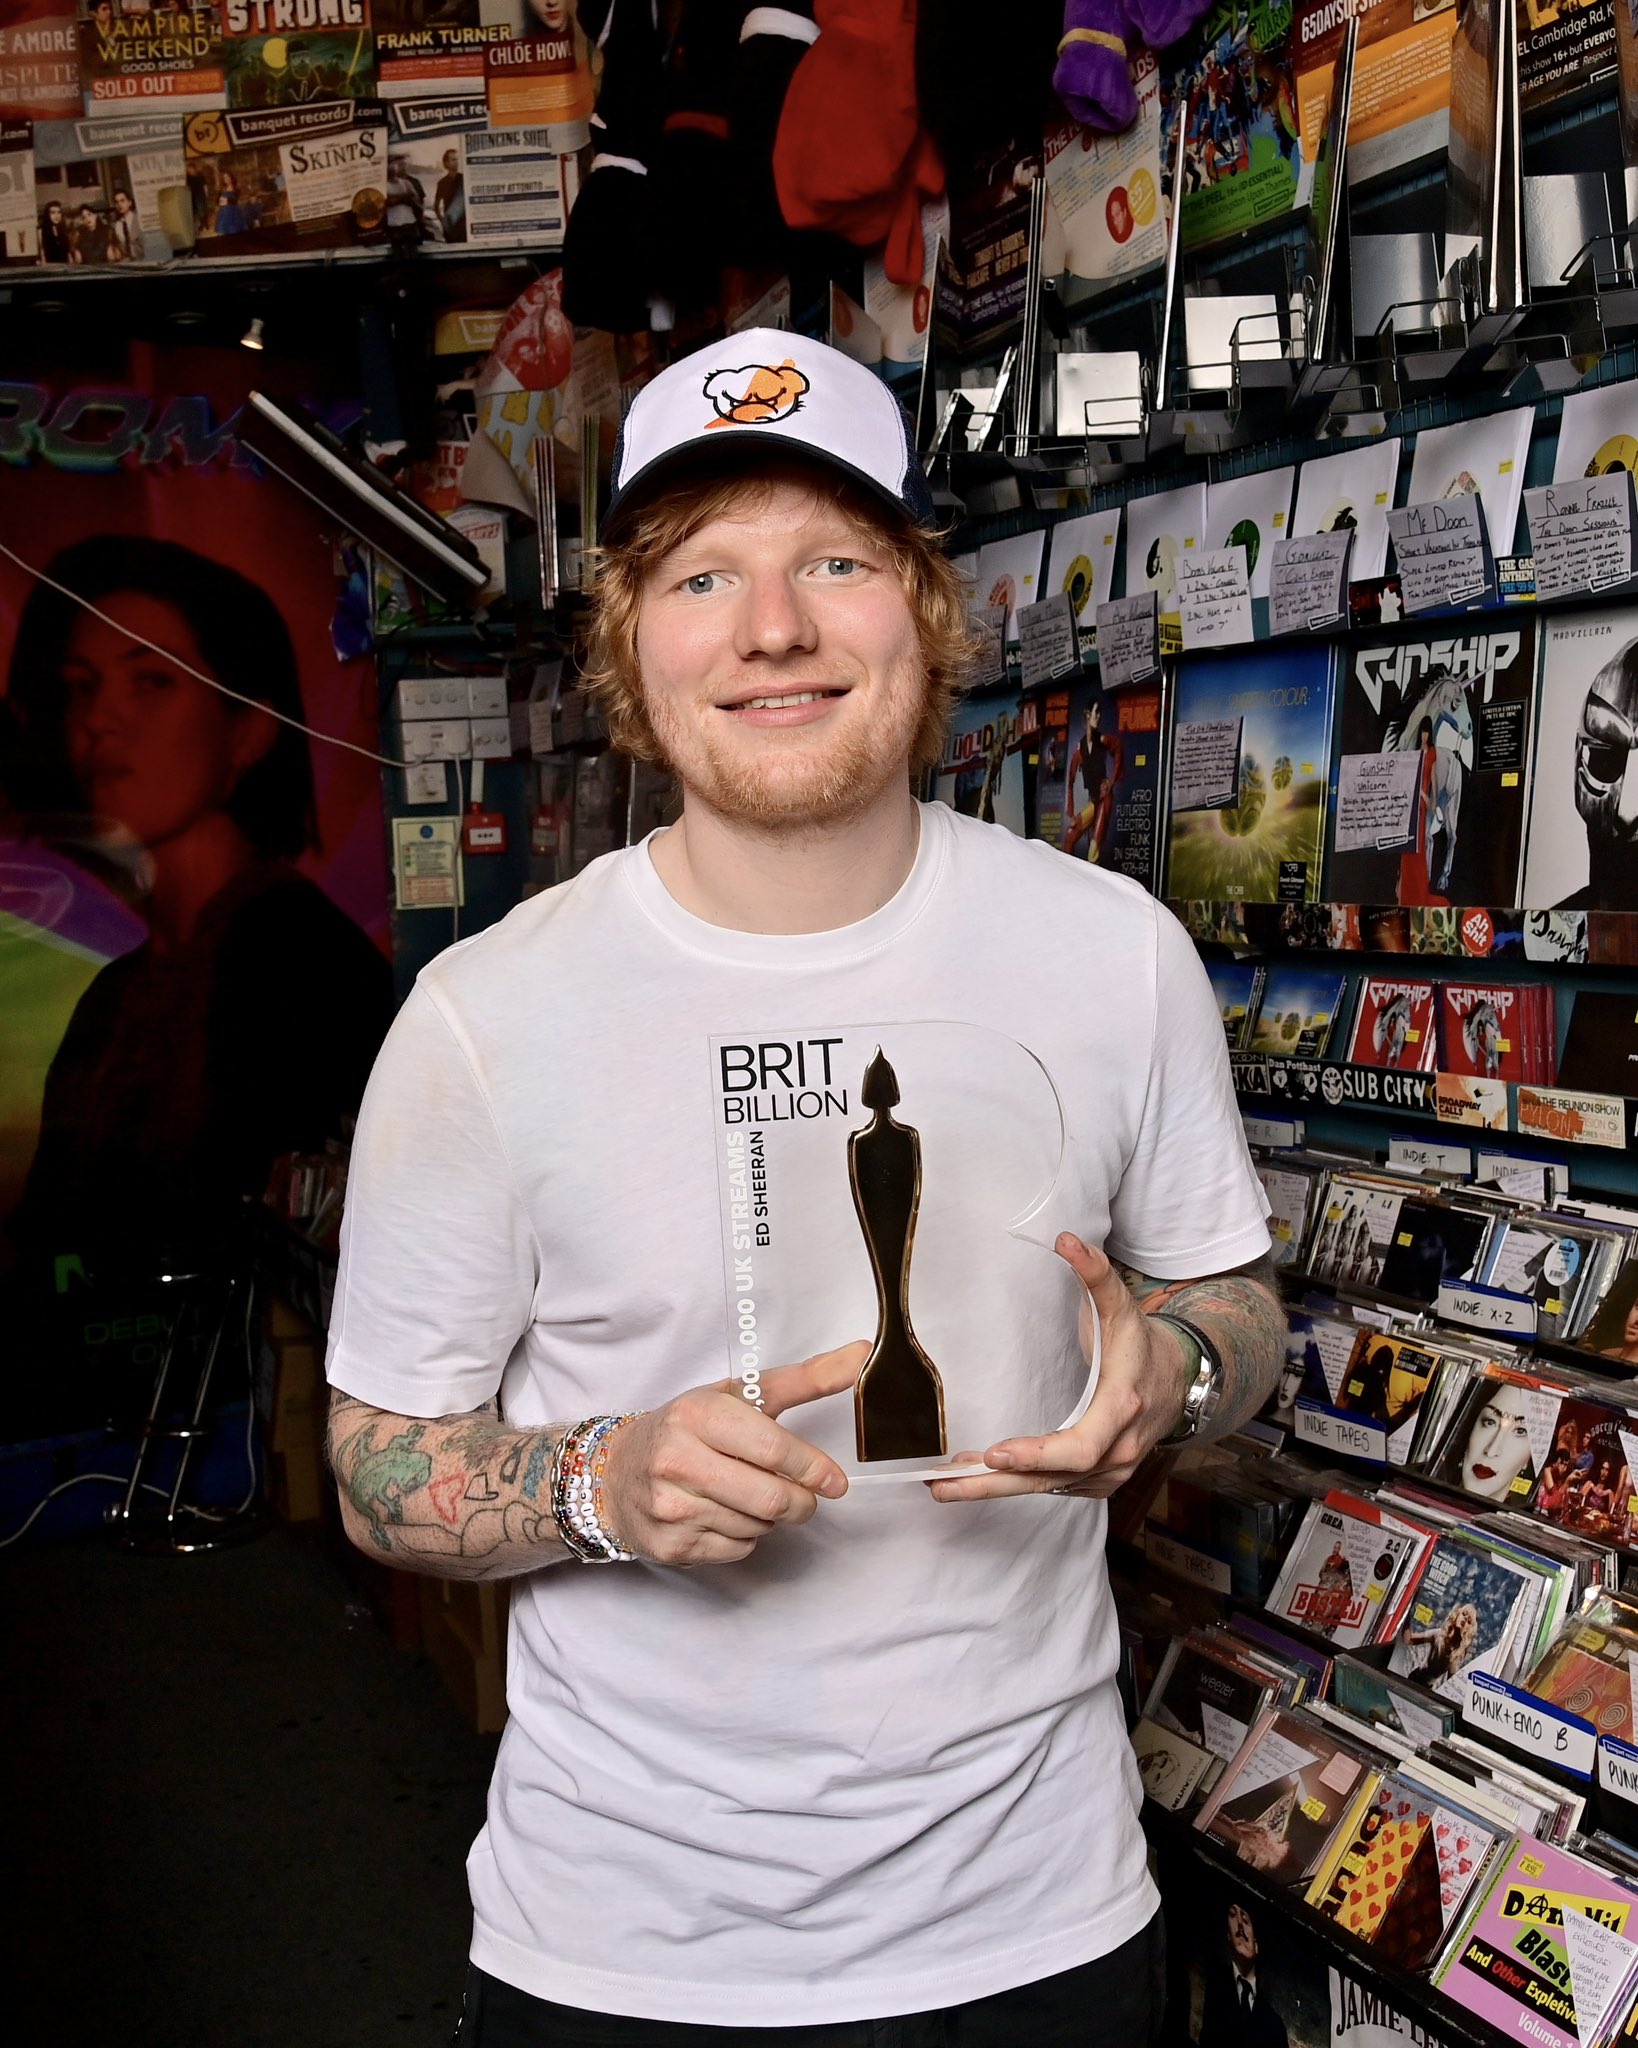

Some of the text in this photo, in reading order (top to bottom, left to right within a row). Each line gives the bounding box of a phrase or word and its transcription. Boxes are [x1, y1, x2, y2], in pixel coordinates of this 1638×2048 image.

[95, 13, 206, 38] VAMPIRE
[376, 26, 512, 49] FRANK TURNER
[1531, 16, 1588, 51] Cambridge
[13, 26, 76, 54] AMORÉ
[97, 37, 210, 61] WEEKEND
[489, 42, 533, 66] CHLÖE
[1532, 56, 1552, 72] show
[1553, 48, 1569, 62] 16+
[1569, 43, 1583, 56] but
[121, 59, 195, 74] GOOD SHOES
[1528, 74, 1544, 90] AGE
[1545, 66, 1561, 81] YOU
[1562, 60, 1580, 75] ARE
[93, 75, 175, 99] SOLD OUT
[240, 106, 383, 134] banquet records .com
[409, 103, 466, 122] banquet
[89, 122, 146, 141] banquet
[289, 130, 377, 175] SKINTS
[1499, 558, 1516, 571] THE
[1499, 571, 1535, 581] ANTHEM
[1355, 631, 1520, 716] GUNSHIP
[1118, 705, 1158, 730] FUNK
[1131, 789, 1152, 802] AFRO
[1116, 803, 1152, 818] FUTURIST
[1116, 818, 1151, 832] ELECTRO
[1130, 833, 1151, 846] FUNK
[1124, 847, 1150, 861] SPACE
[1469, 912, 1489, 931] Ah
[1368, 981, 1432, 1012] GUNSHIP
[1446, 986, 1514, 1020] GUNSHIP
[720, 1038, 844, 1093] BRIT
[1268, 1058, 1321, 1073] Dan Potthast
[1342, 1069, 1378, 1100] SUB
[723, 1089, 849, 1125] BILLION
[1438, 1095, 1481, 1112] BROADWAY
[1438, 1104, 1463, 1117] CALLS
[1542, 1096, 1621, 1118] THE REUNION SHOW
[1436, 1154, 1446, 1168] T
[749, 1130, 771, 1247] ED SHEERAN
[726, 1130, 765, 1413] ,000,000 UK STREAMS
[1453, 1298, 1484, 1318] INDIE:
[1302, 1414, 1370, 1453] INDIE TAPES
[1320, 1512, 1344, 1533] GREA
[1427, 1568, 1449, 1587] WITCH
[1428, 1554, 1442, 1570] THE
[1441, 1557, 1458, 1577] GOOD
[1200, 1671, 1236, 1698] weezer
[1553, 1726, 1569, 1752] B
[1515, 1927, 1570, 1991] Blast
[1465, 1943, 1578, 2027] And Other Expletive
[1336, 1972, 1404, 2037] JAMIE
[1517, 2011, 1566, 2048] Volume
